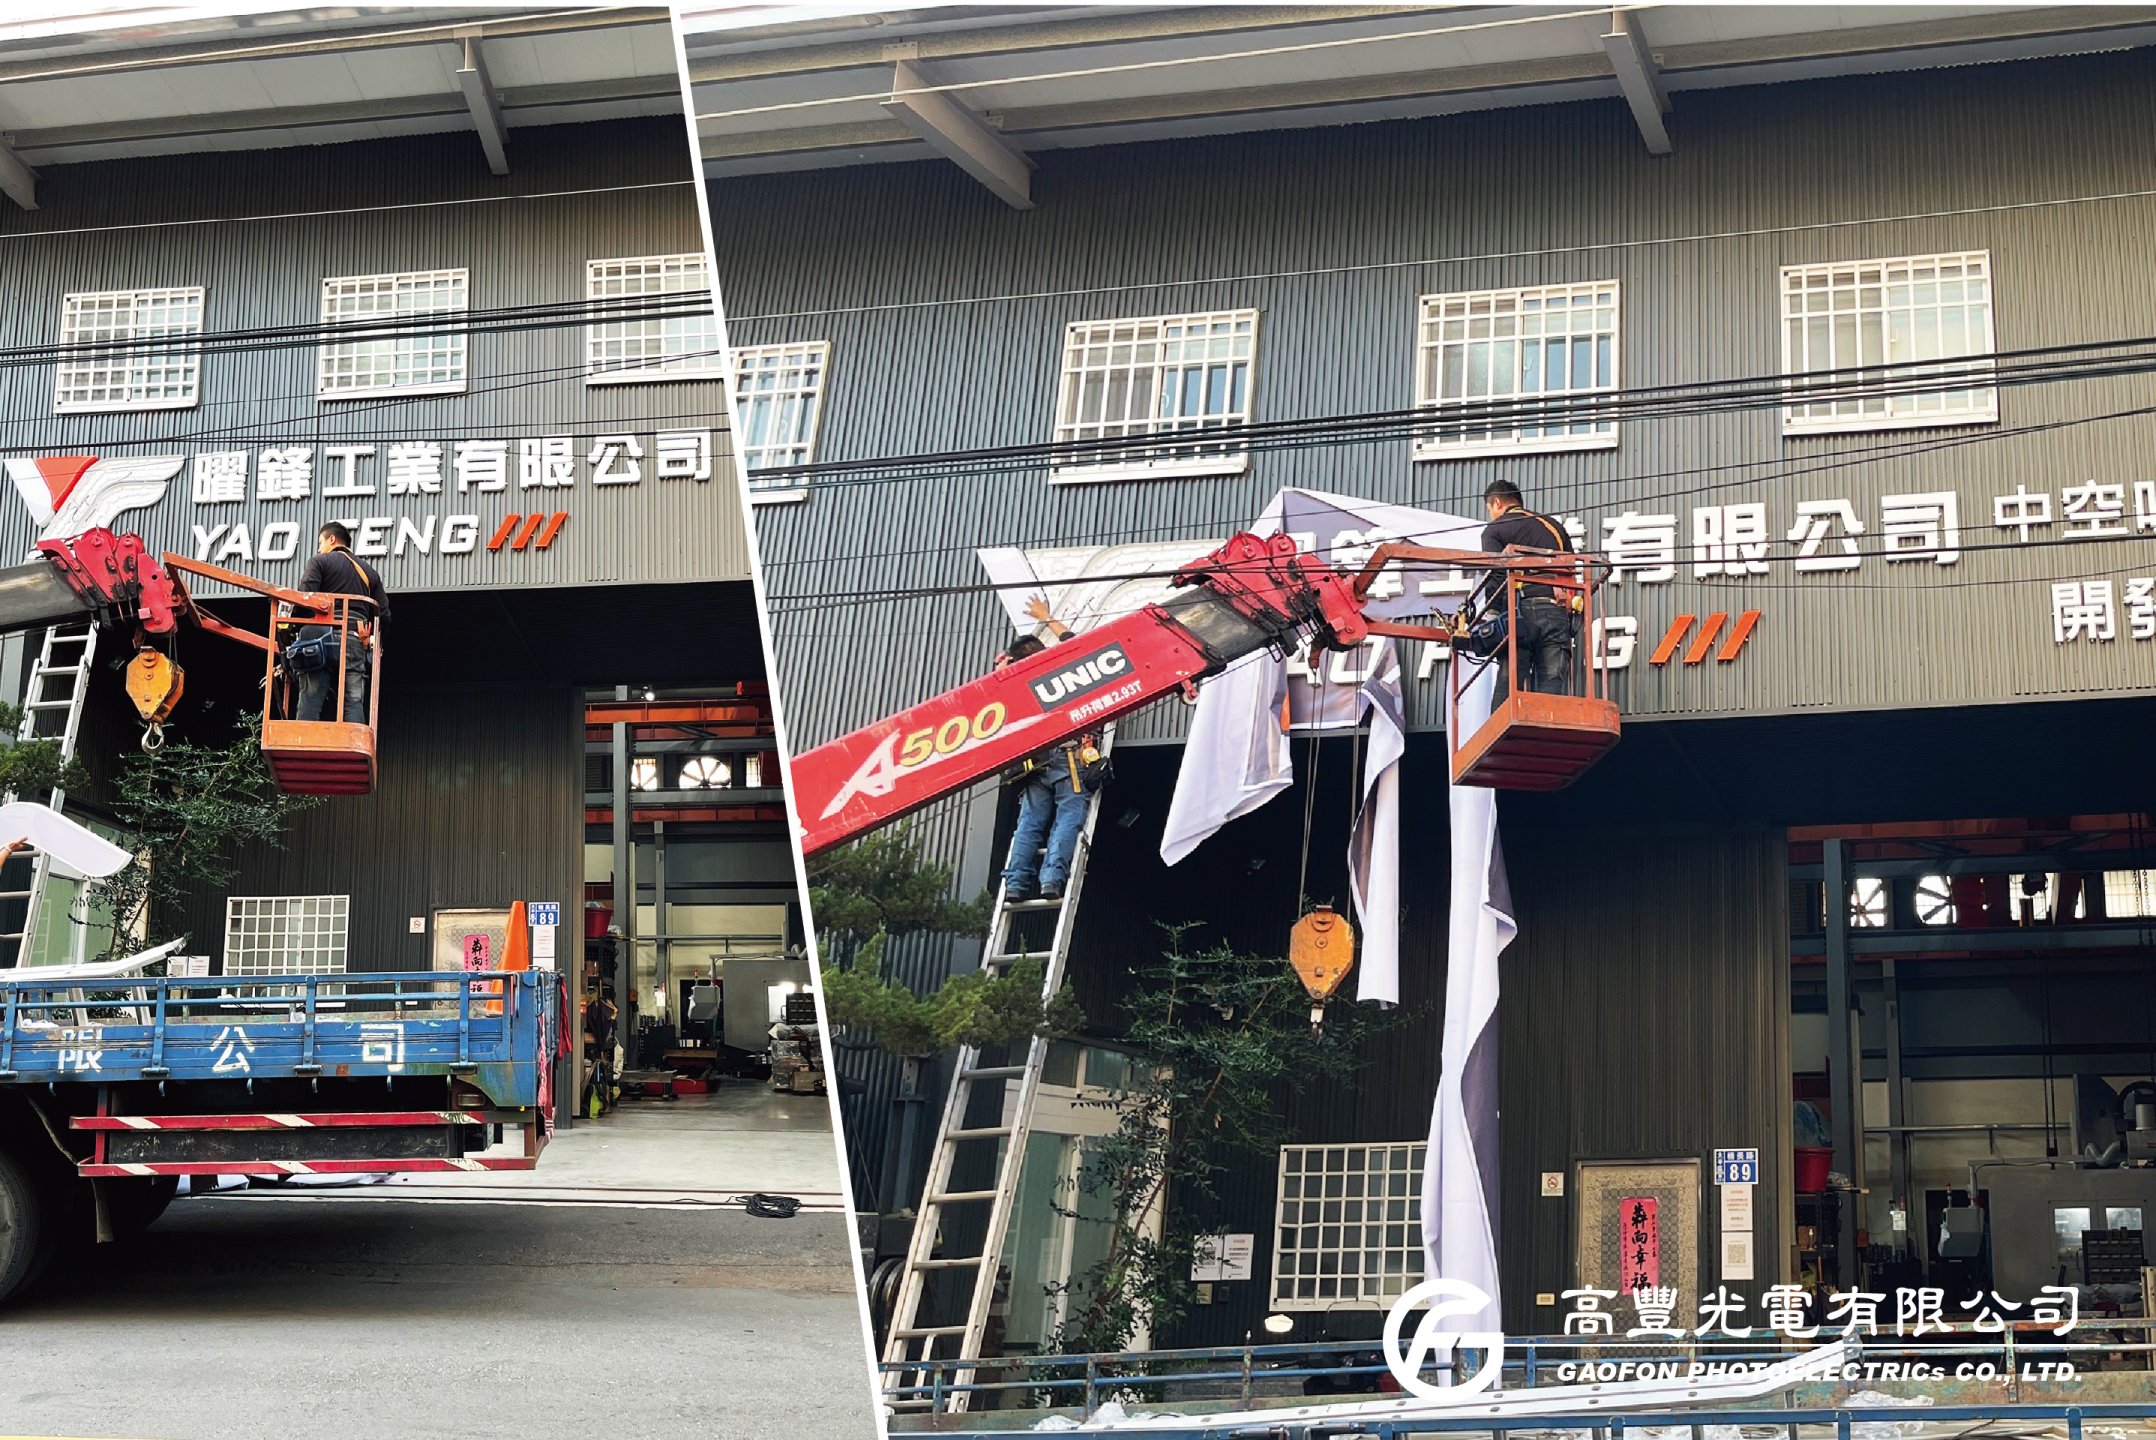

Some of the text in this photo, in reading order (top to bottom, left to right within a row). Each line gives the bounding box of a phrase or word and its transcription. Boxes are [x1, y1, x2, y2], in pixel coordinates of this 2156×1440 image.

[191, 428, 712, 503] 曜鋒工業有限公司
[192, 521, 301, 562] YAO
[1034, 649, 1128, 704] UNIC
[539, 912, 555, 925] 89
[1729, 1163, 1752, 1181] 89
